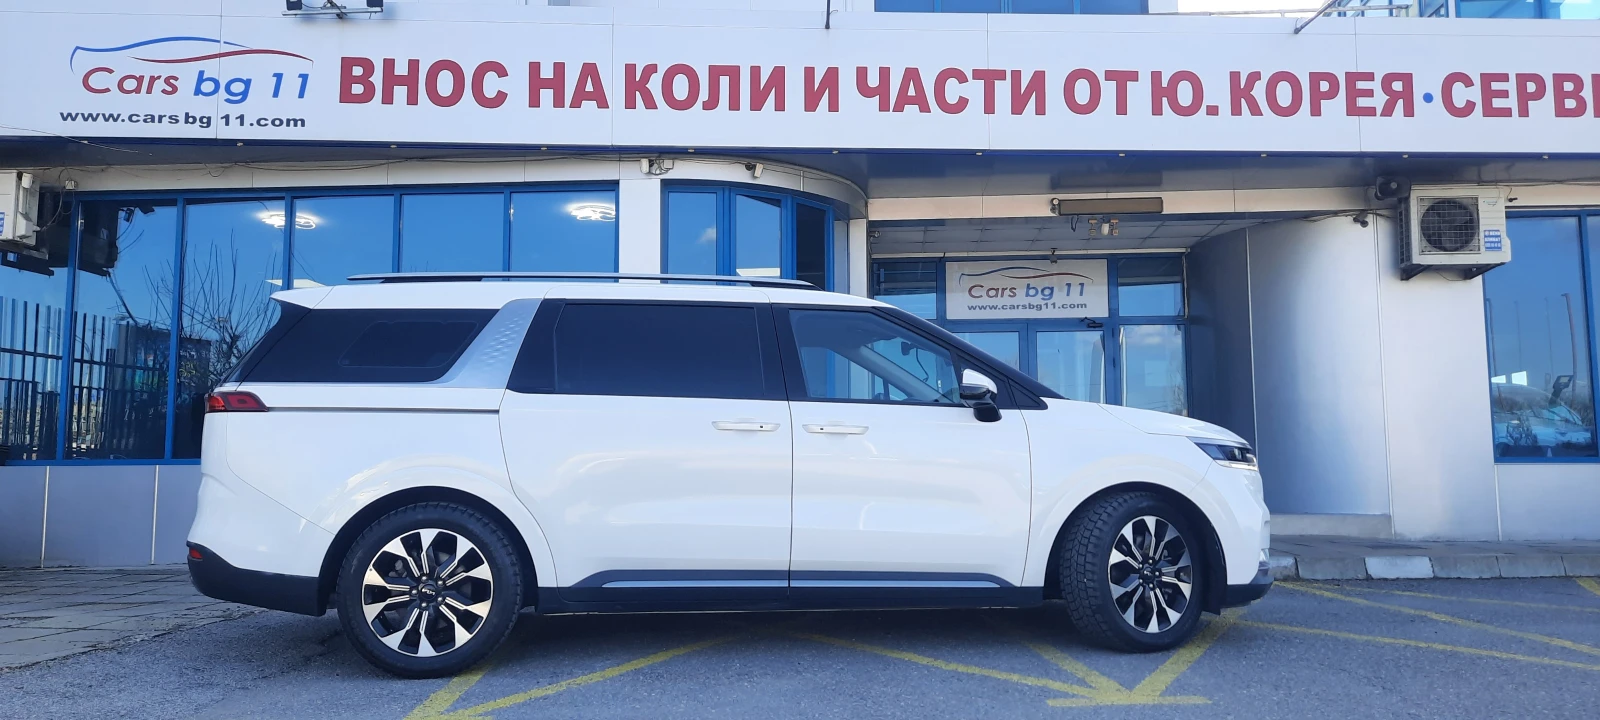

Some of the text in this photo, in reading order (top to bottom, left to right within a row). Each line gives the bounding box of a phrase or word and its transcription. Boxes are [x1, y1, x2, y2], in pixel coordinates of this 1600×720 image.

[82, 66, 309, 105] Cars bg 11
[339, 56, 1600, 118] ВНОС НА КОЛИ И ЧАСТИ ОТ Ю. КОРЕЯ СЕРВ
[967, 282, 1085, 301] Cars bg 11
[967, 302, 1087, 312] www.carsbg11.com
